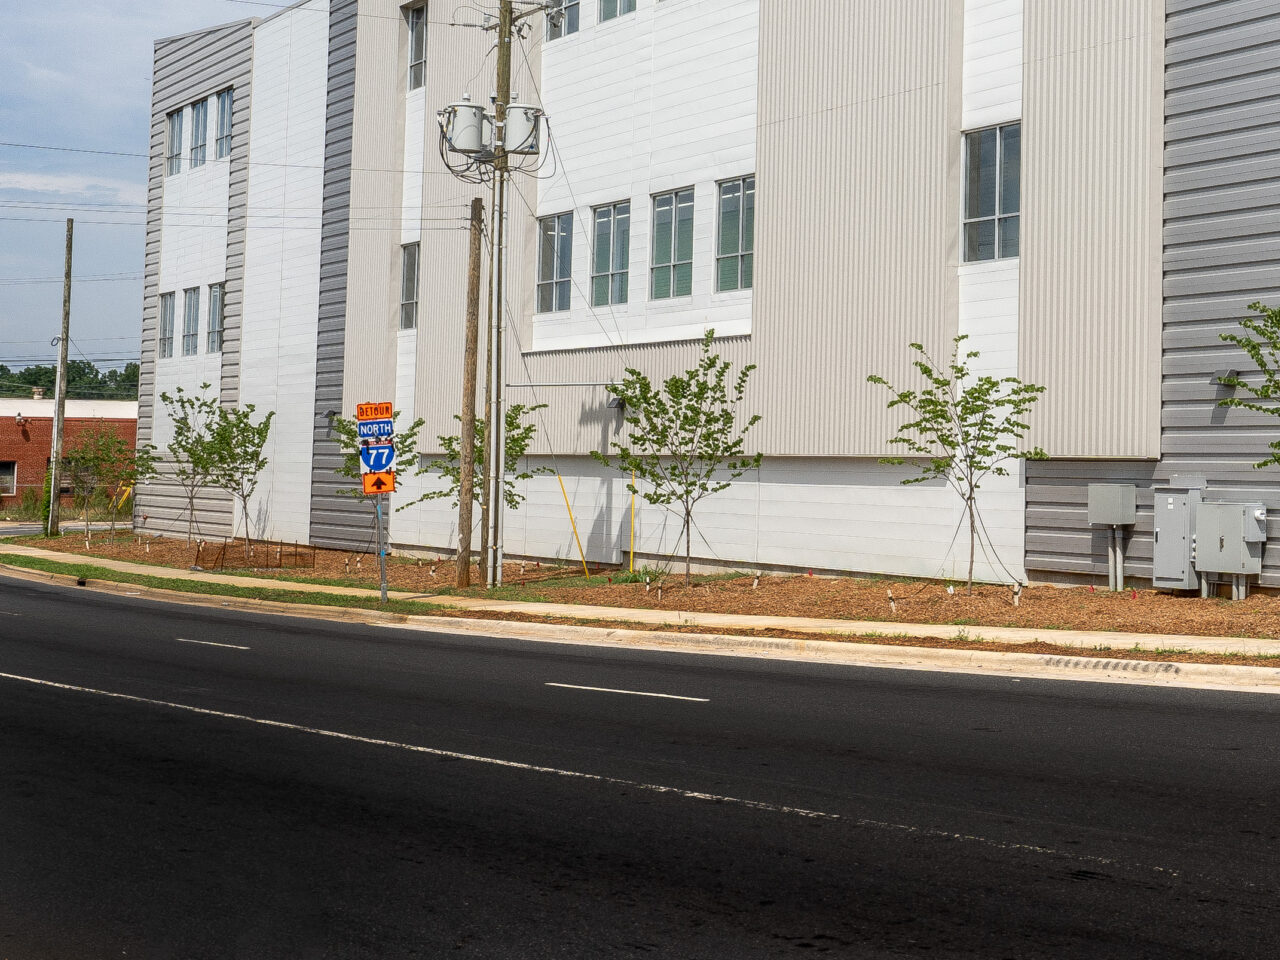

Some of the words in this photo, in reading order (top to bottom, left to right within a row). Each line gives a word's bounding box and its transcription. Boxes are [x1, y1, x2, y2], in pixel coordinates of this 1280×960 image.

[359, 406, 390, 417] DETOUR
[360, 423, 391, 434] NORTH
[369, 449, 389, 465] 77
